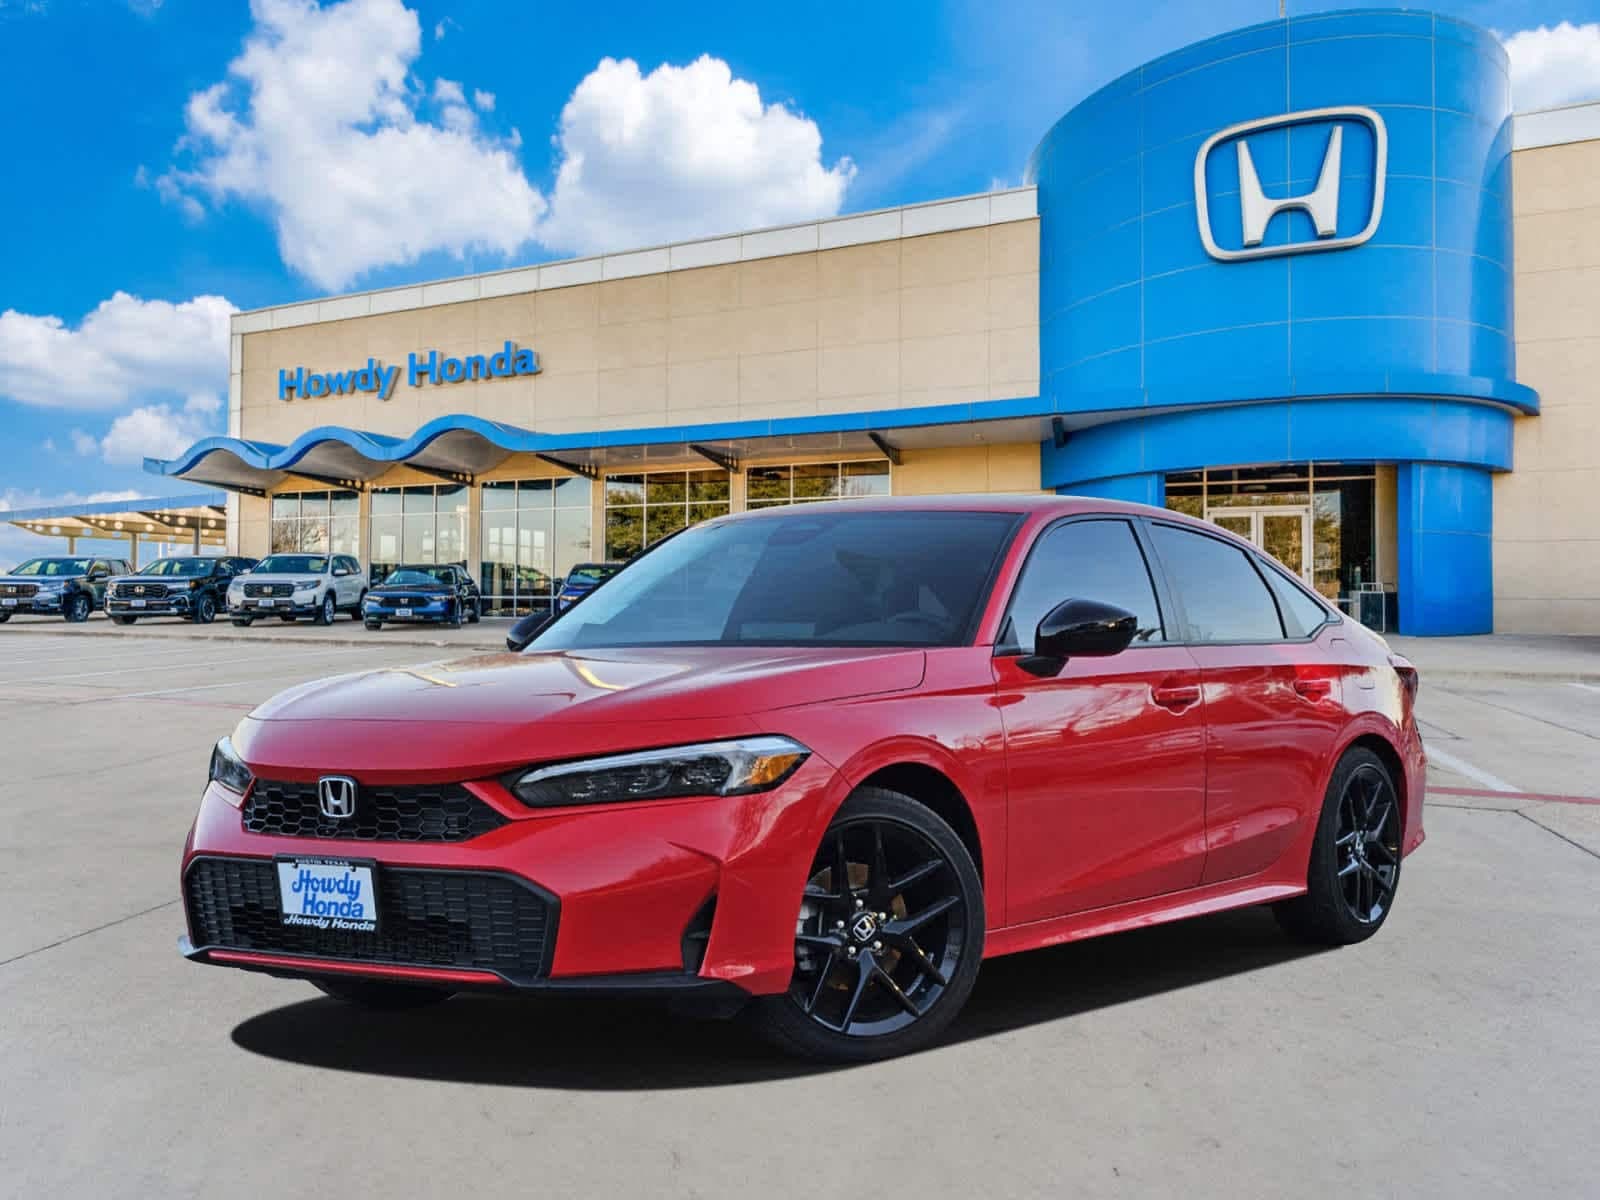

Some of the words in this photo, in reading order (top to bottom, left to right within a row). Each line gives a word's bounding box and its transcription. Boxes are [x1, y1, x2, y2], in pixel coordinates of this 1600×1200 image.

[278, 357, 400, 402] Howdy
[407, 340, 542, 388] Honda
[291, 869, 361, 901] Howdy
[302, 893, 364, 918] Honda
[283, 914, 329, 929] Howdy
[331, 918, 376, 932] Honda
